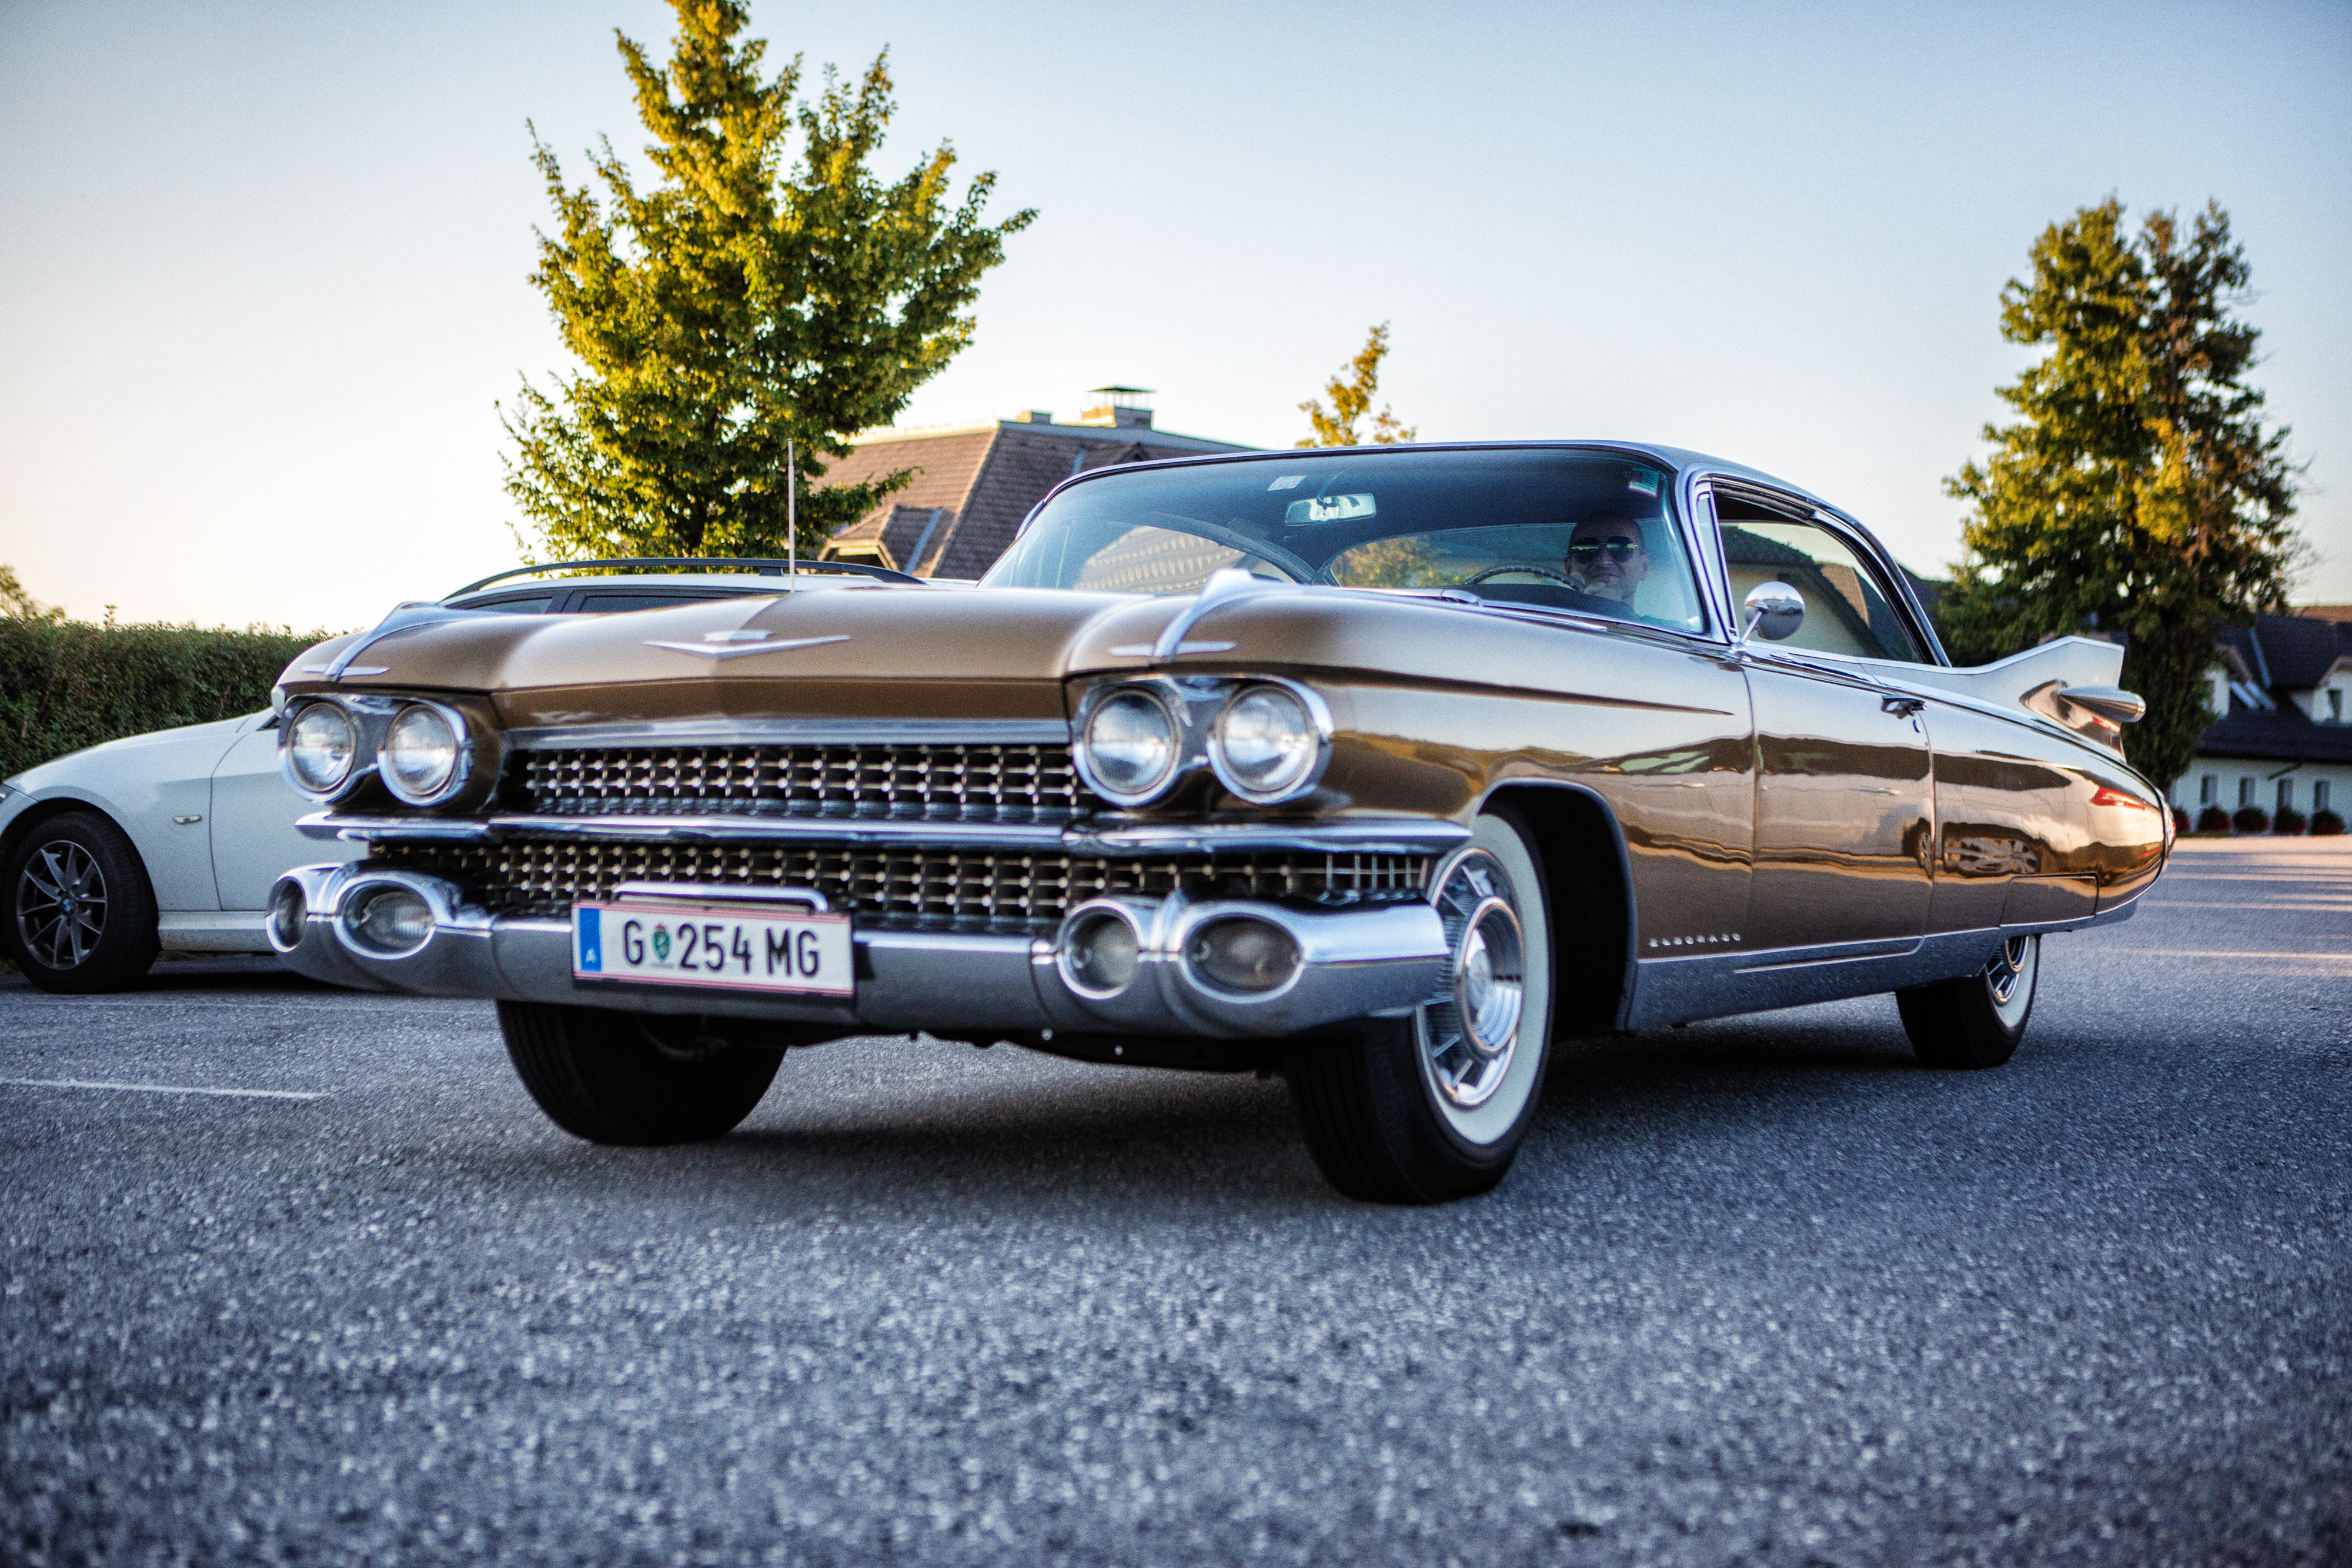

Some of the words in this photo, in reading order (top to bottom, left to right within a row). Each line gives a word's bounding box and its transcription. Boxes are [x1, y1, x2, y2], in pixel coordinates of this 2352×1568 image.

[586, 948, 597, 964] A
[624, 920, 644, 965] G
[677, 923, 752, 974] 254
[766, 927, 820, 977] MG
